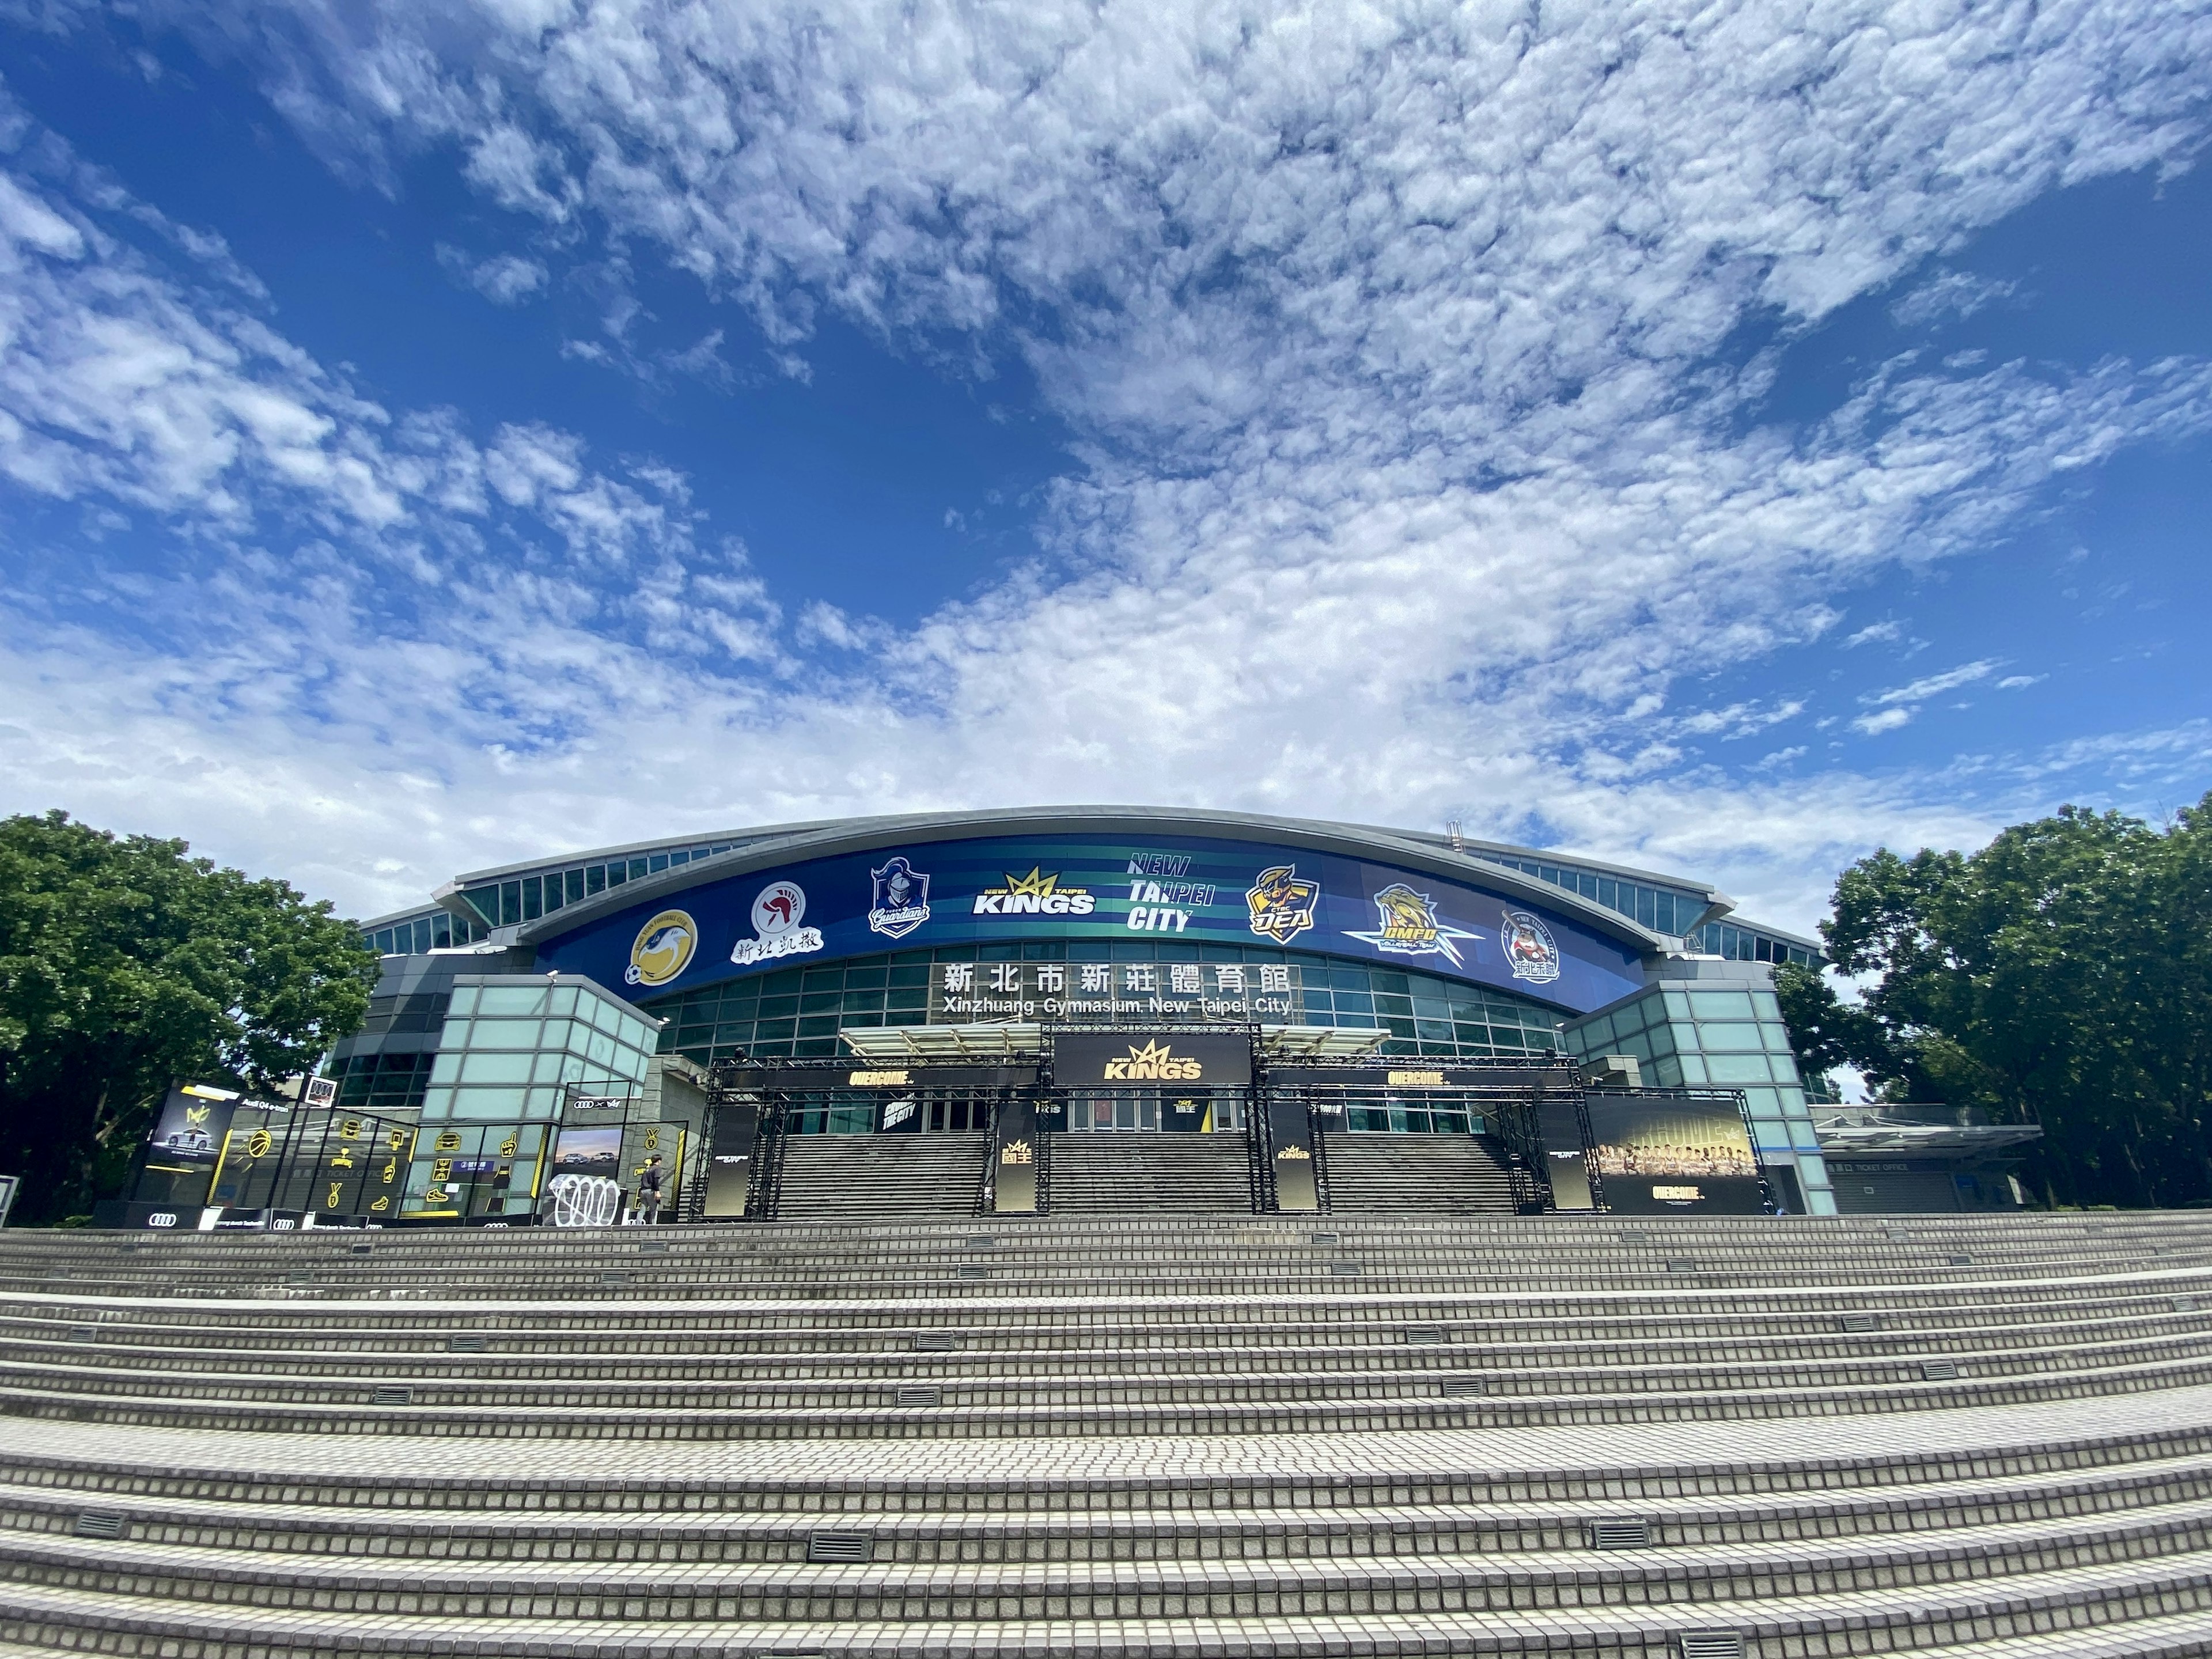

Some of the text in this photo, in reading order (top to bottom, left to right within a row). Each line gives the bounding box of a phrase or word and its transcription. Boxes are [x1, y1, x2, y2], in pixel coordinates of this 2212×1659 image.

[1127, 853, 1191, 878] NEW
[1129, 879, 1215, 907] TAIPEI
[973, 894, 1095, 914] KINGS
[653, 915, 677, 925] FOOTBALL
[676, 917, 688, 927] CLUB
[871, 906, 927, 929] Guardians
[1127, 906, 1194, 933] CITY
[1255, 909, 1309, 931] DEA
[944, 963, 1290, 993] 新北市新莊體育館
[943, 997, 1035, 1016] Xinzhuang
[1149, 997, 1190, 1013] New
[1197, 997, 1247, 1016] Taipei
[1255, 997, 1290, 1016] City
[849, 1071, 909, 1086] OVERCOME
[1104, 1062, 1202, 1080] KINGS
[1388, 1071, 1444, 1085] OVERCOME
[241, 1098, 259, 1107] Audi
[259, 1101, 270, 1110] Q4
[1002, 1153, 1032, 1164] 國王
[1883, 1163, 1908, 1171] OFFICE
[1652, 1185, 1699, 1199] OVERCOME
